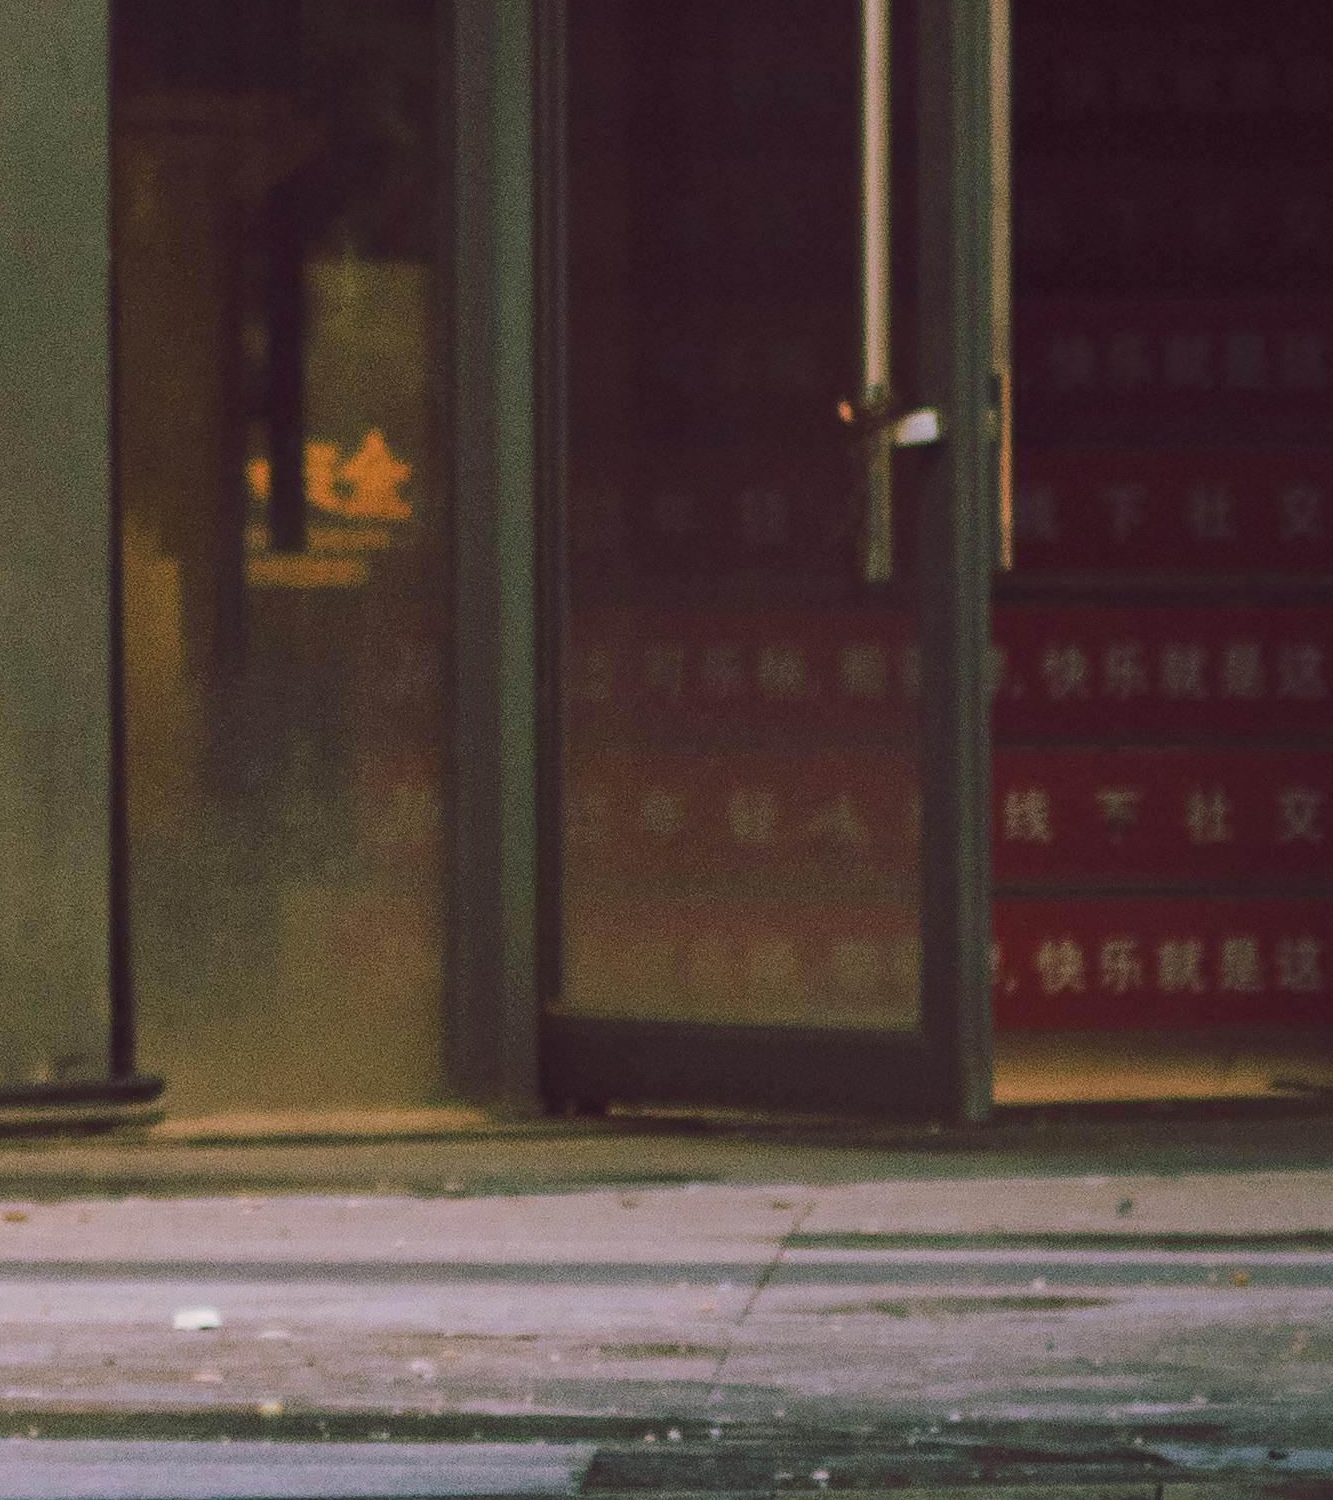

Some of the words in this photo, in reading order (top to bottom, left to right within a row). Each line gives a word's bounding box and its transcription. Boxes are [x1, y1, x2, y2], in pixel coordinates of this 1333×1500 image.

[990, 934, 1326, 996] ,快乐就是这
